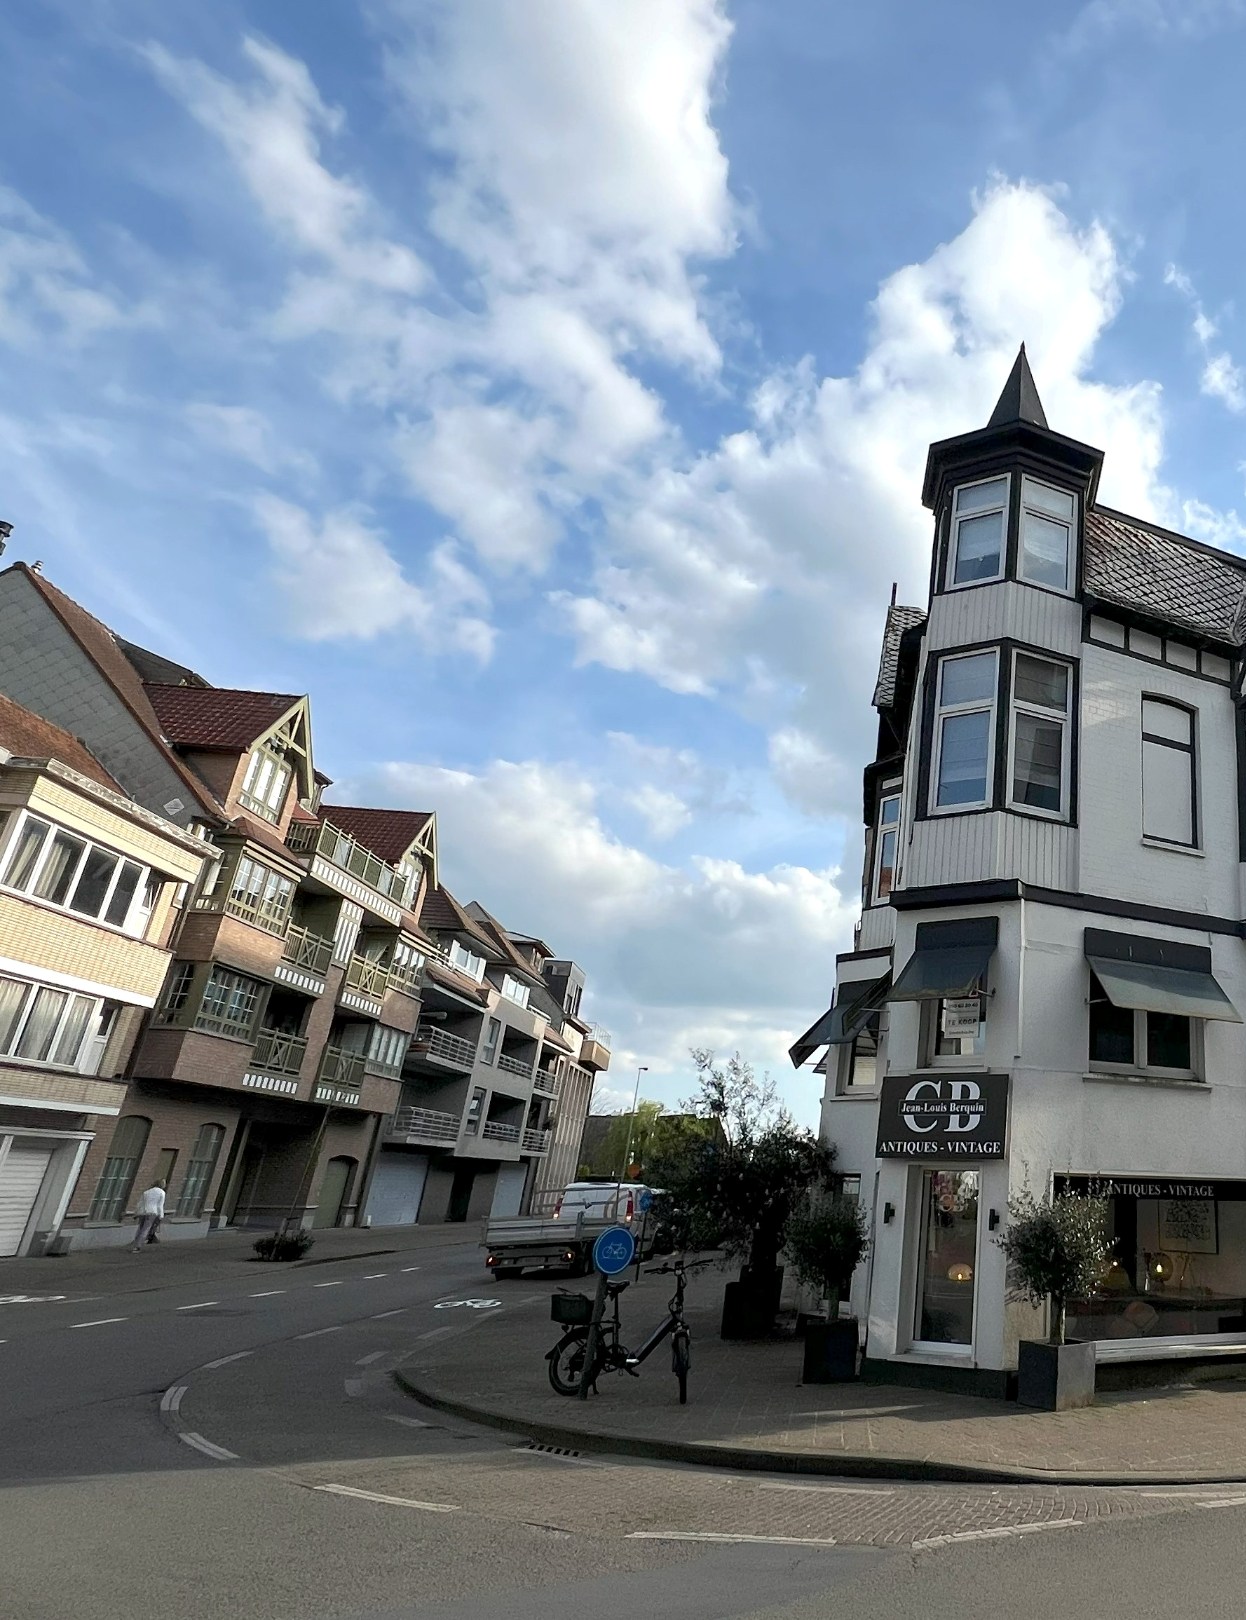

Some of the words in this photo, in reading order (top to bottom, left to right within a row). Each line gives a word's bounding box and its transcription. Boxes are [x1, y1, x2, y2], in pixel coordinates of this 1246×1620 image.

[901, 1102, 947, 1113] Jean-Louis
[949, 1102, 984, 1115] Berquin
[880, 1141, 938, 1155] ANTIQUES
[947, 1141, 1001, 1154] VINTAGE
[1168, 1184, 1214, 1196] VINTAGE
